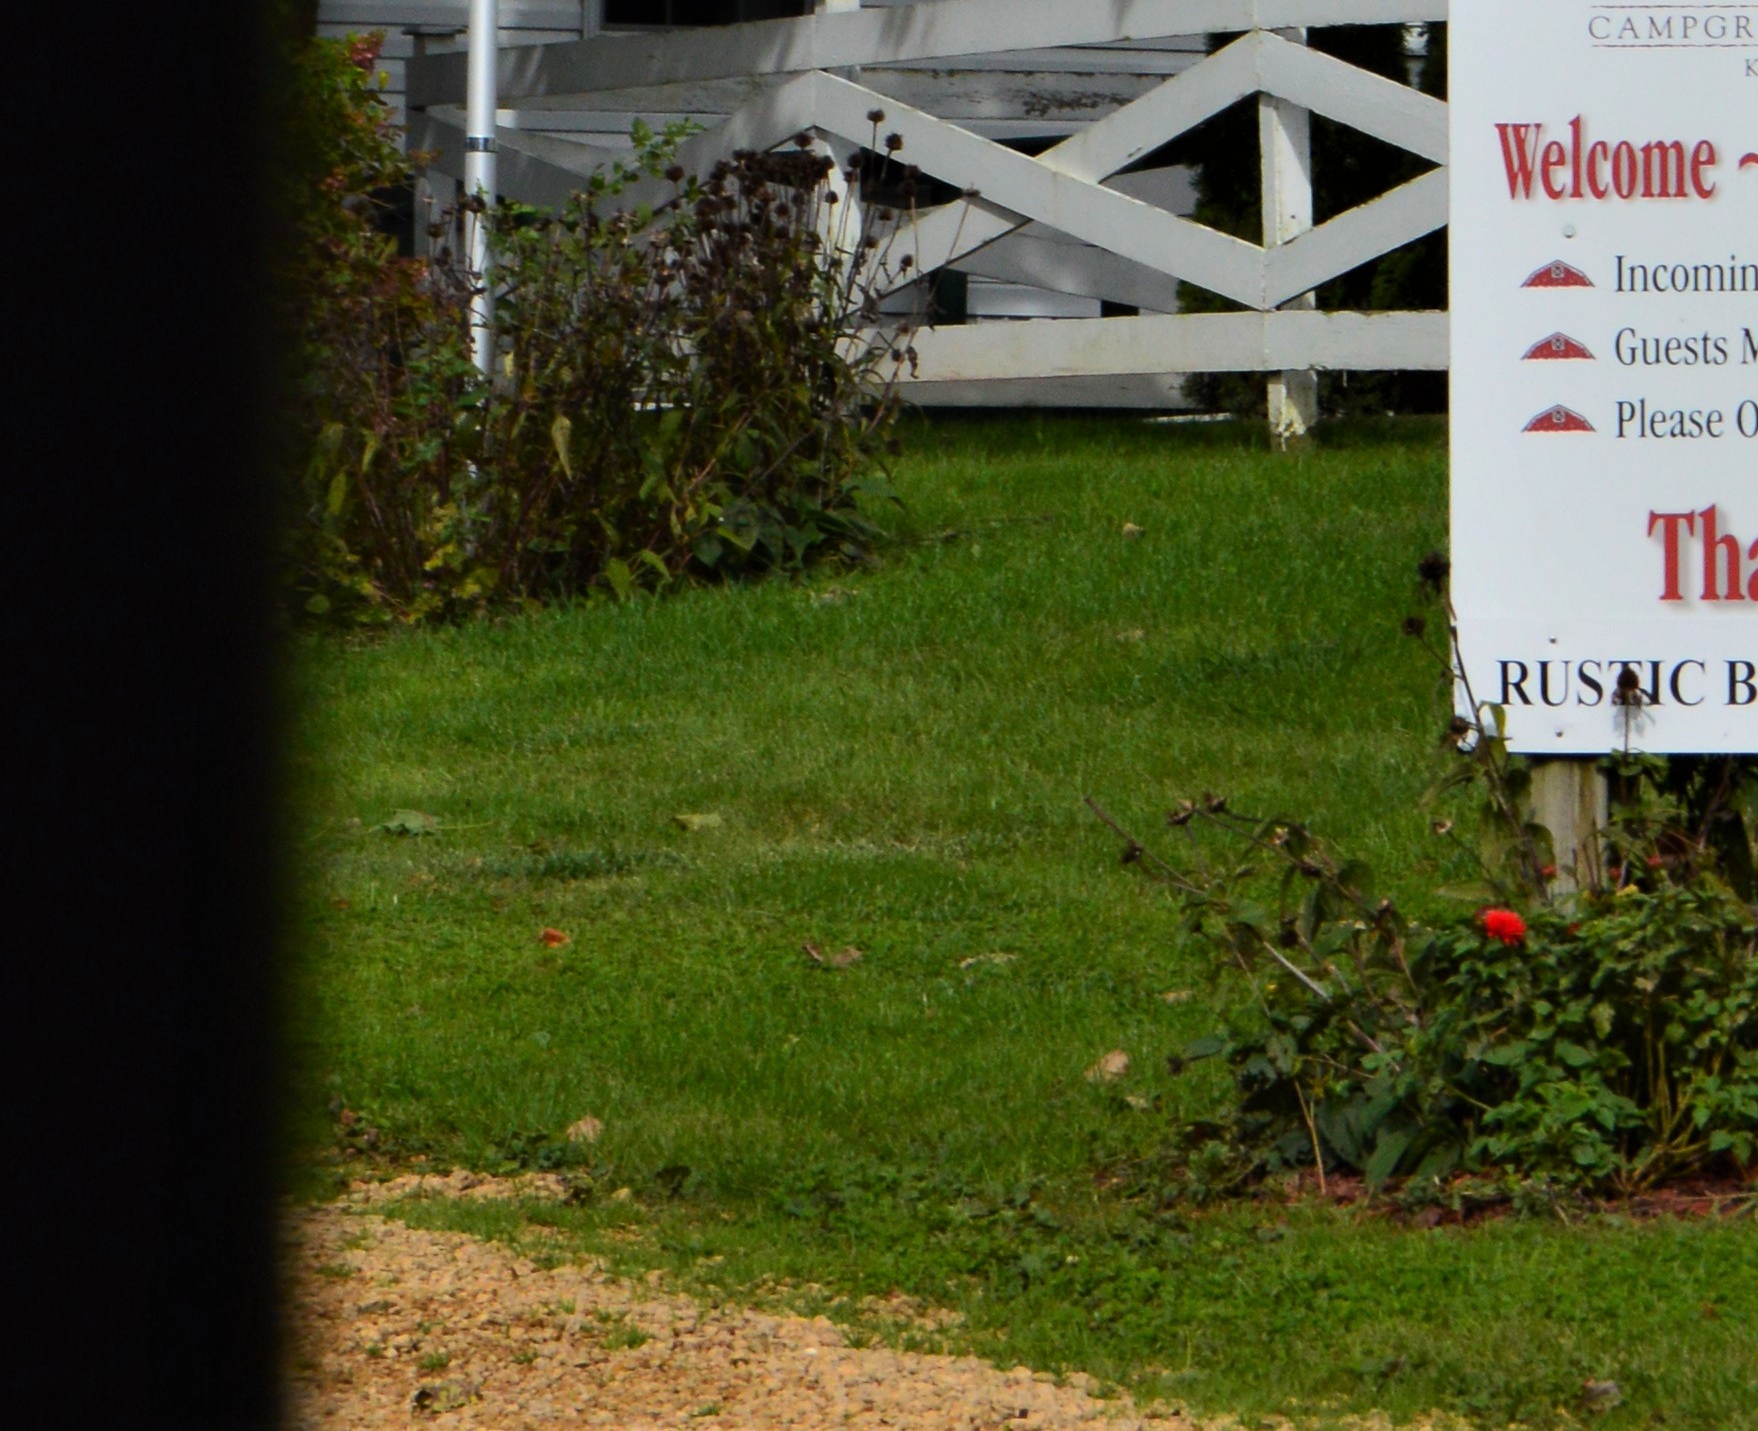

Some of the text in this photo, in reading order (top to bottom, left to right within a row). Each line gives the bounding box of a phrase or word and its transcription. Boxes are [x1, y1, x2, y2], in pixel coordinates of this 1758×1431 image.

[1495, 115, 1717, 201] Welcome
[1614, 327, 1728, 366] Guests
[1615, 398, 1724, 439] Please
[1496, 659, 1706, 707] RUSTIC
